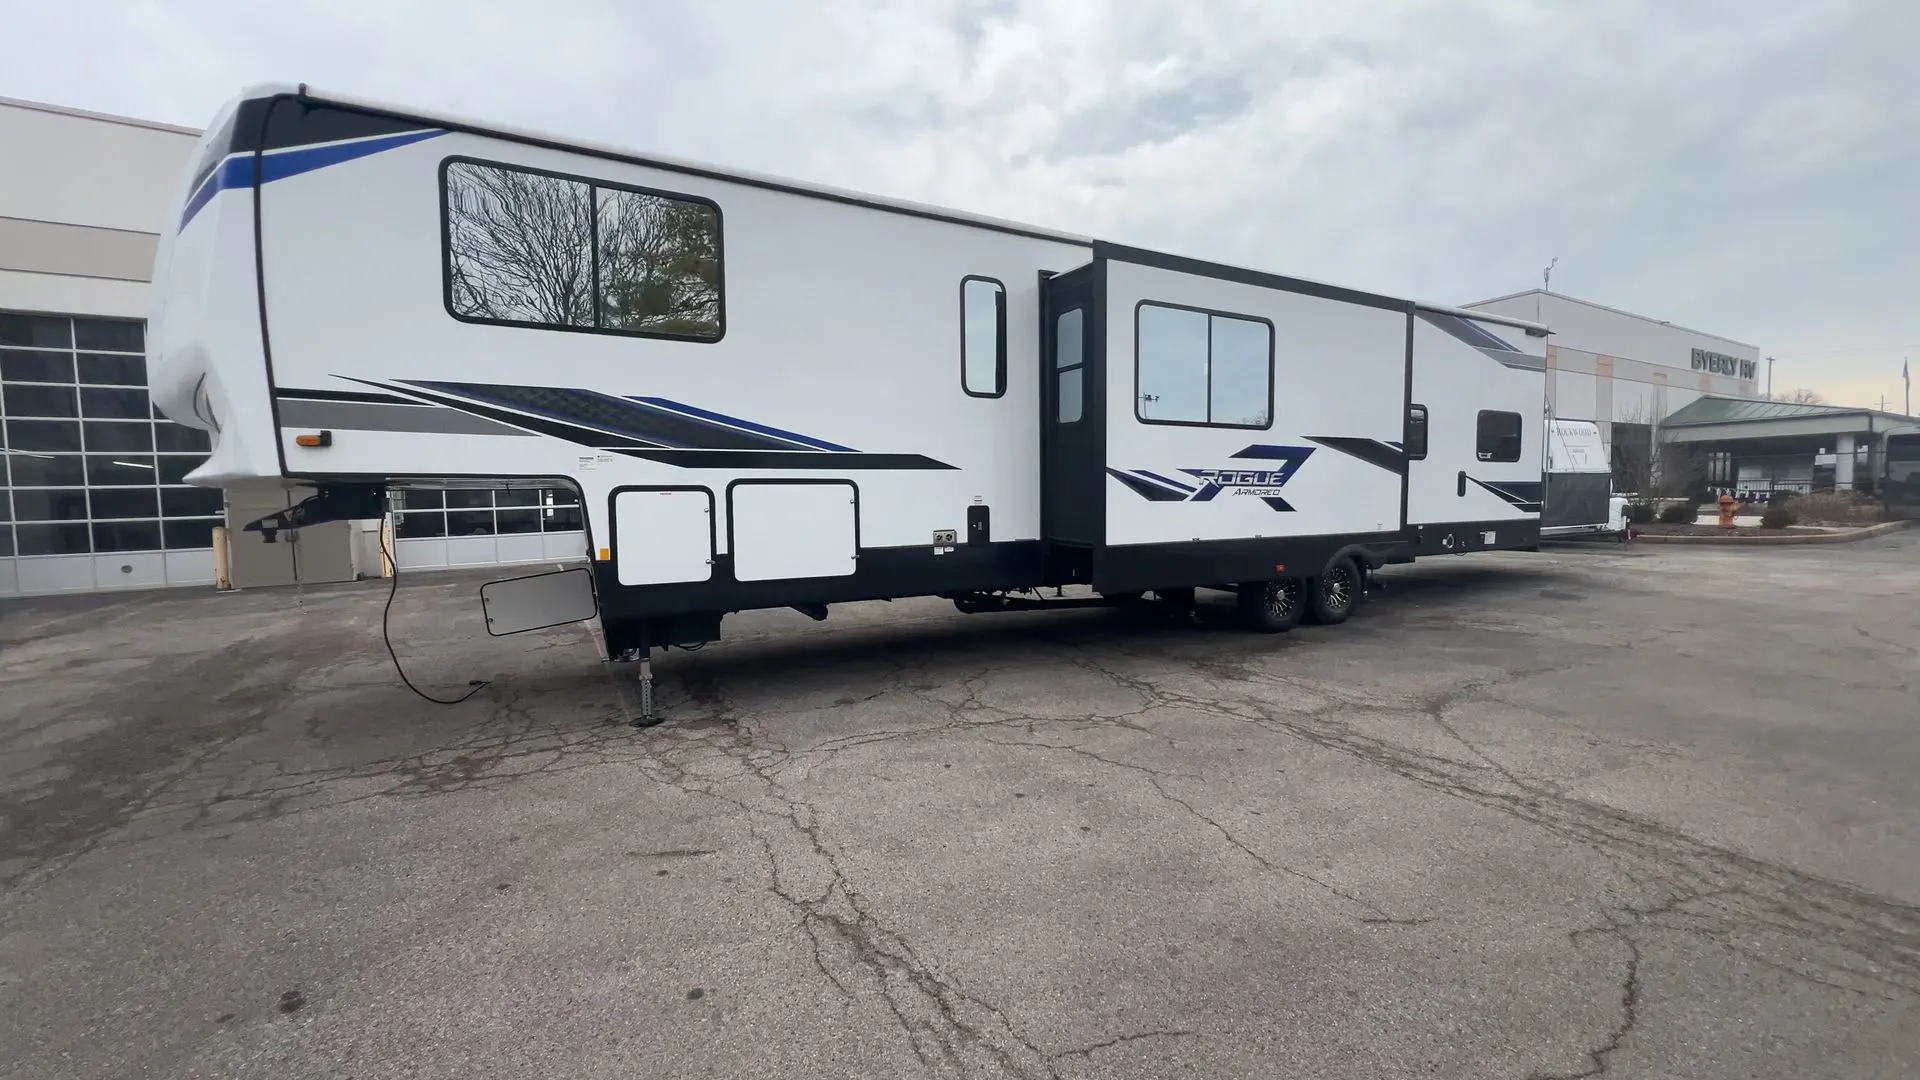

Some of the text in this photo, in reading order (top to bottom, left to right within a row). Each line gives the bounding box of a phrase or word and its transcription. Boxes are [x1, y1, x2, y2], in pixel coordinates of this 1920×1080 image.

[1691, 347, 1757, 380] BYERLY RV
[1198, 469, 1284, 487] ROGUE
[1232, 488, 1281, 496] ARMORED
